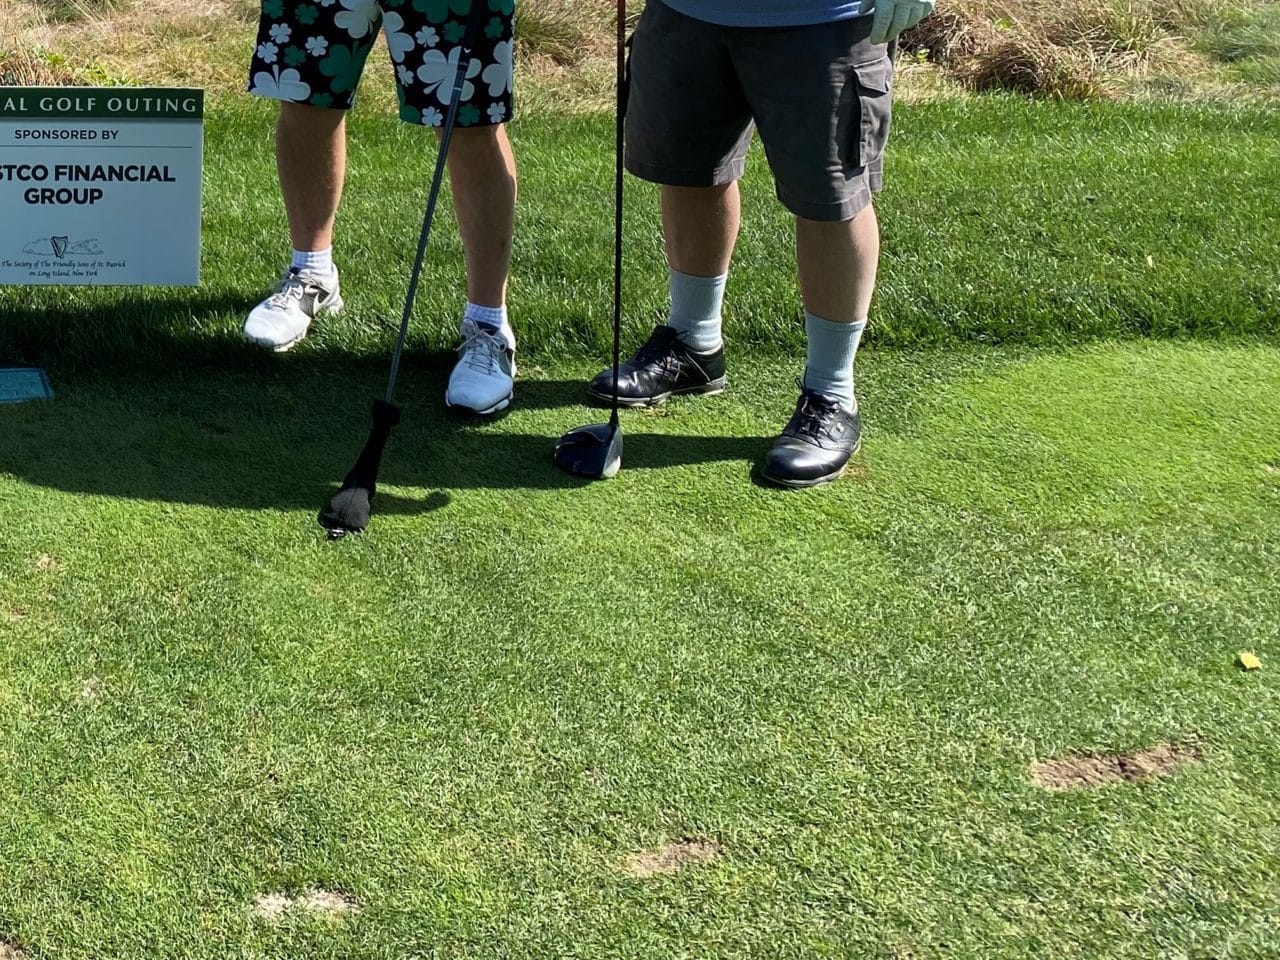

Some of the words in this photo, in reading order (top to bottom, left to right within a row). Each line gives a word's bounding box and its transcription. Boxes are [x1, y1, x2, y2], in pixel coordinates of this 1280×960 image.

[39, 97, 97, 112] GOLF
[107, 97, 197, 113] OUTING
[14, 129, 98, 140] SPONSORED
[101, 129, 119, 140] BY
[55, 164, 176, 182] FINANCIAL
[23, 188, 104, 205] GROUP
